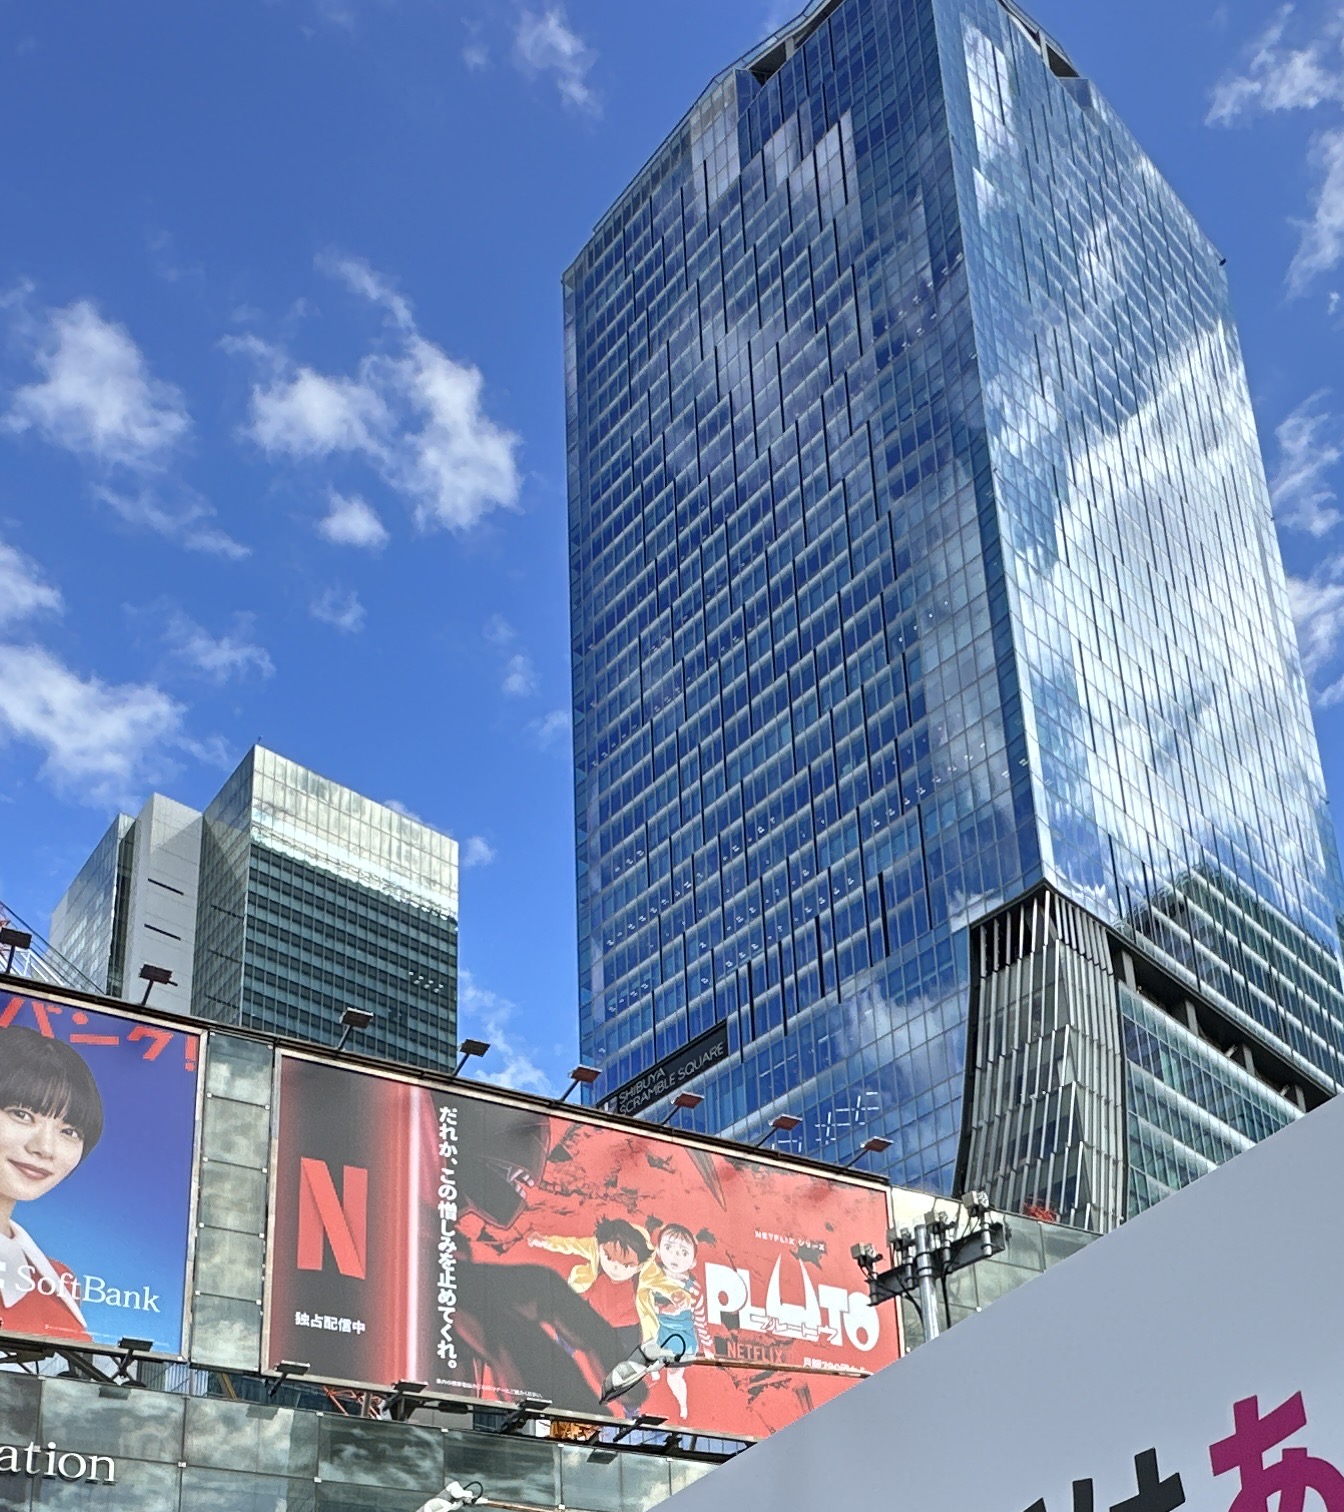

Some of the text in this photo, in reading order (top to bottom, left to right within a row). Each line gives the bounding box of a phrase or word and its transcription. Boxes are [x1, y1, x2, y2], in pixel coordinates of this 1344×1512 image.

[618, 1042, 724, 1115] SCRAMBLE SQUARE
[618, 1067, 665, 1104] SHIBUYA
[754, 1231, 795, 1245] NETFLIX
[14, 1264, 161, 1313] SoftBank
[704, 1253, 880, 1352] PLUTO
[294, 1311, 366, 1335] 独占配信中
[727, 1341, 784, 1364] NETFLIX
